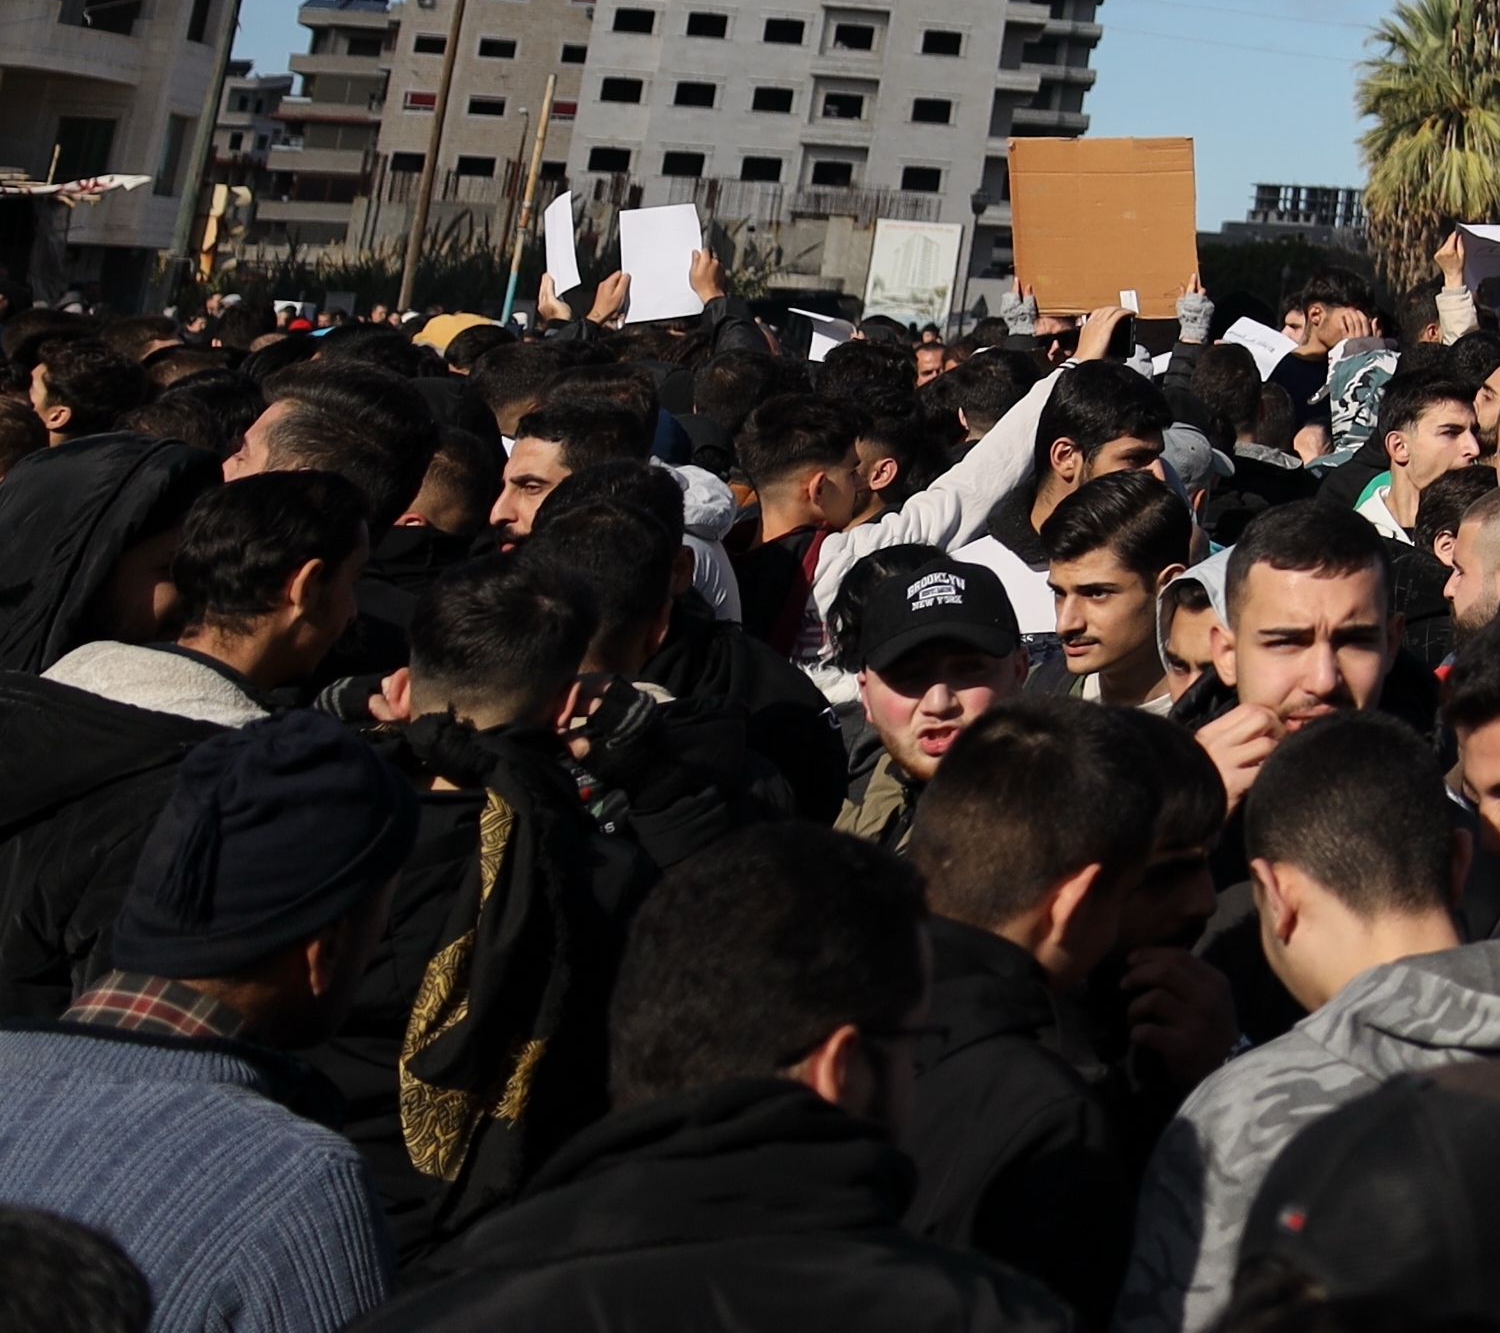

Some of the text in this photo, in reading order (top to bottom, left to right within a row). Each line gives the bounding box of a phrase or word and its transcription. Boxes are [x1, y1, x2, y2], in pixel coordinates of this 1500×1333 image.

[906, 572, 966, 600] BROOKLYN
[911, 594, 964, 611] NEW YORK
